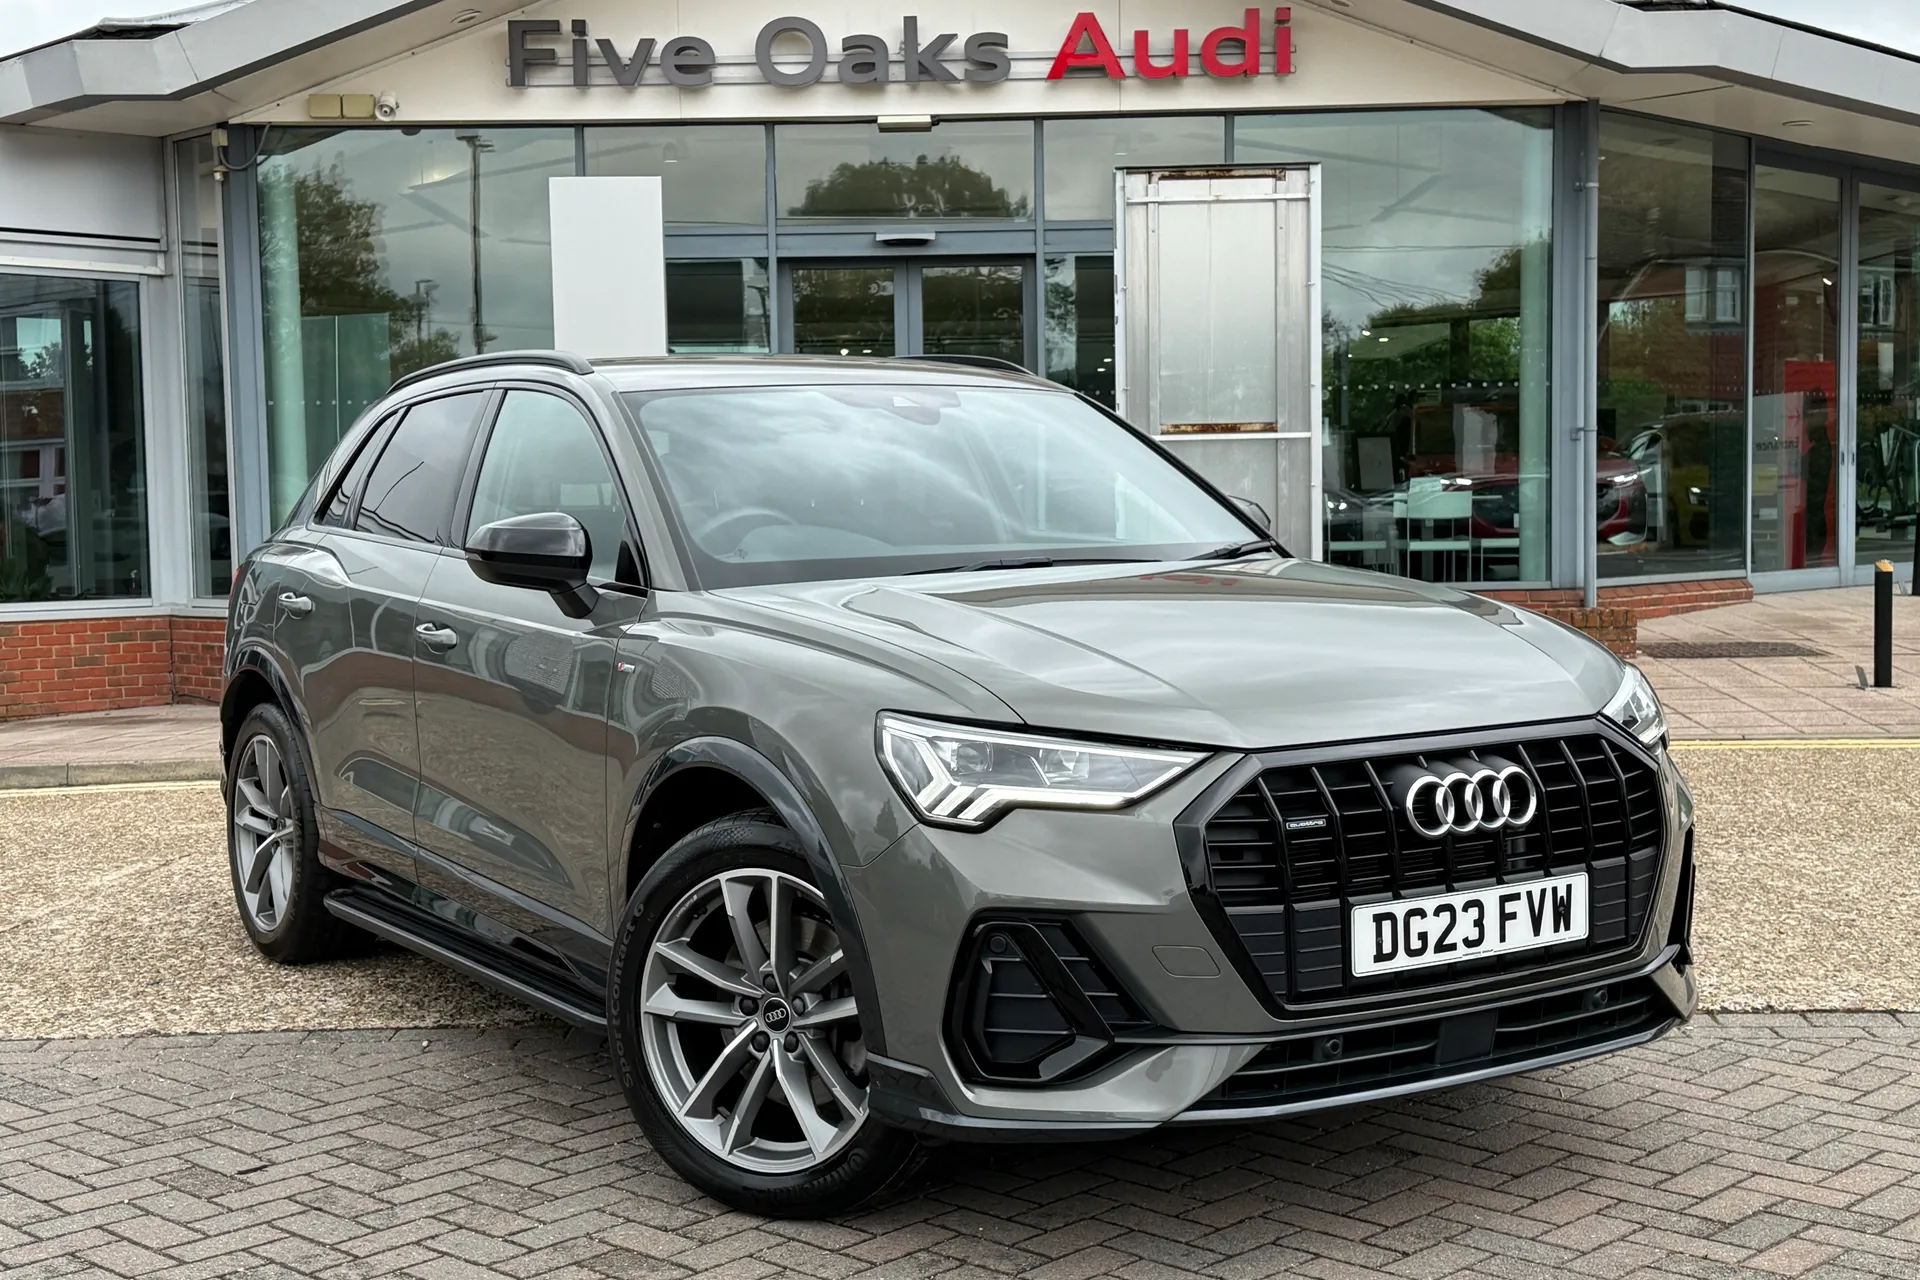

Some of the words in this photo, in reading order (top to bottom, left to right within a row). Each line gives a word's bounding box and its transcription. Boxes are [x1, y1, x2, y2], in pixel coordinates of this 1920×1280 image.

[508, 19, 716, 88] Five
[755, 15, 1012, 87] Oaks
[1046, 7, 1292, 80] Audi
[1372, 898, 1485, 963] DG23
[1499, 884, 1572, 943] FVW
